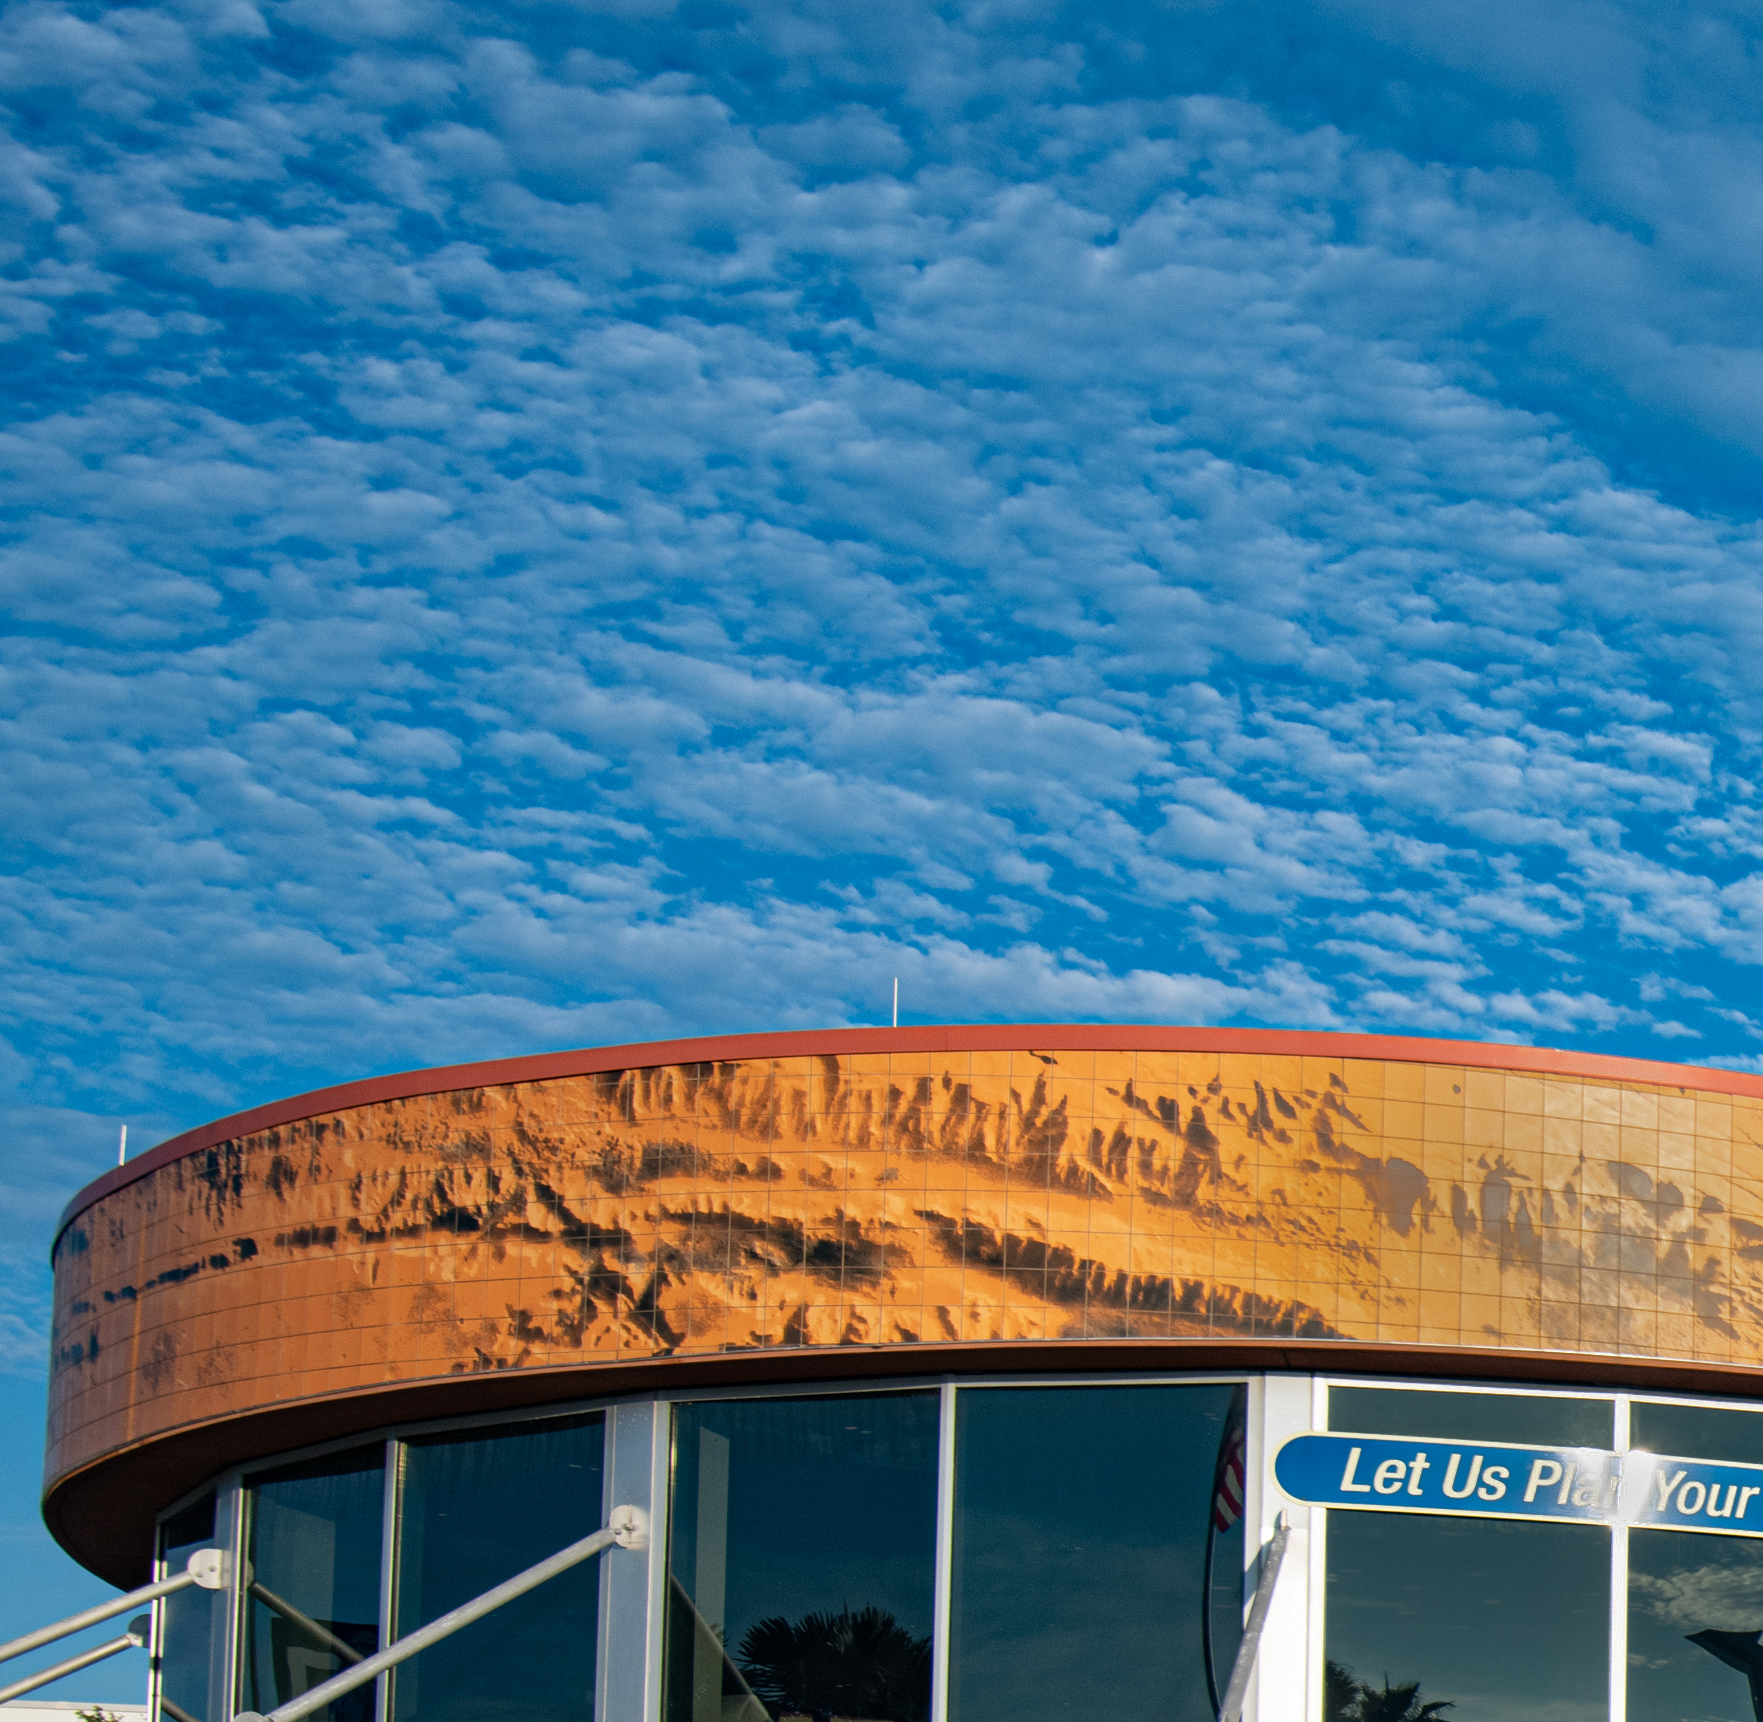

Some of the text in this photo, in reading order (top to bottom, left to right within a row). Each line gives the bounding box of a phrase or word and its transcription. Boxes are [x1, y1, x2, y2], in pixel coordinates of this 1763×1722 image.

[1340, 1447, 1431, 1496] Let
[1441, 1453, 1510, 1501] Us
[1656, 1468, 1760, 1519] Your
